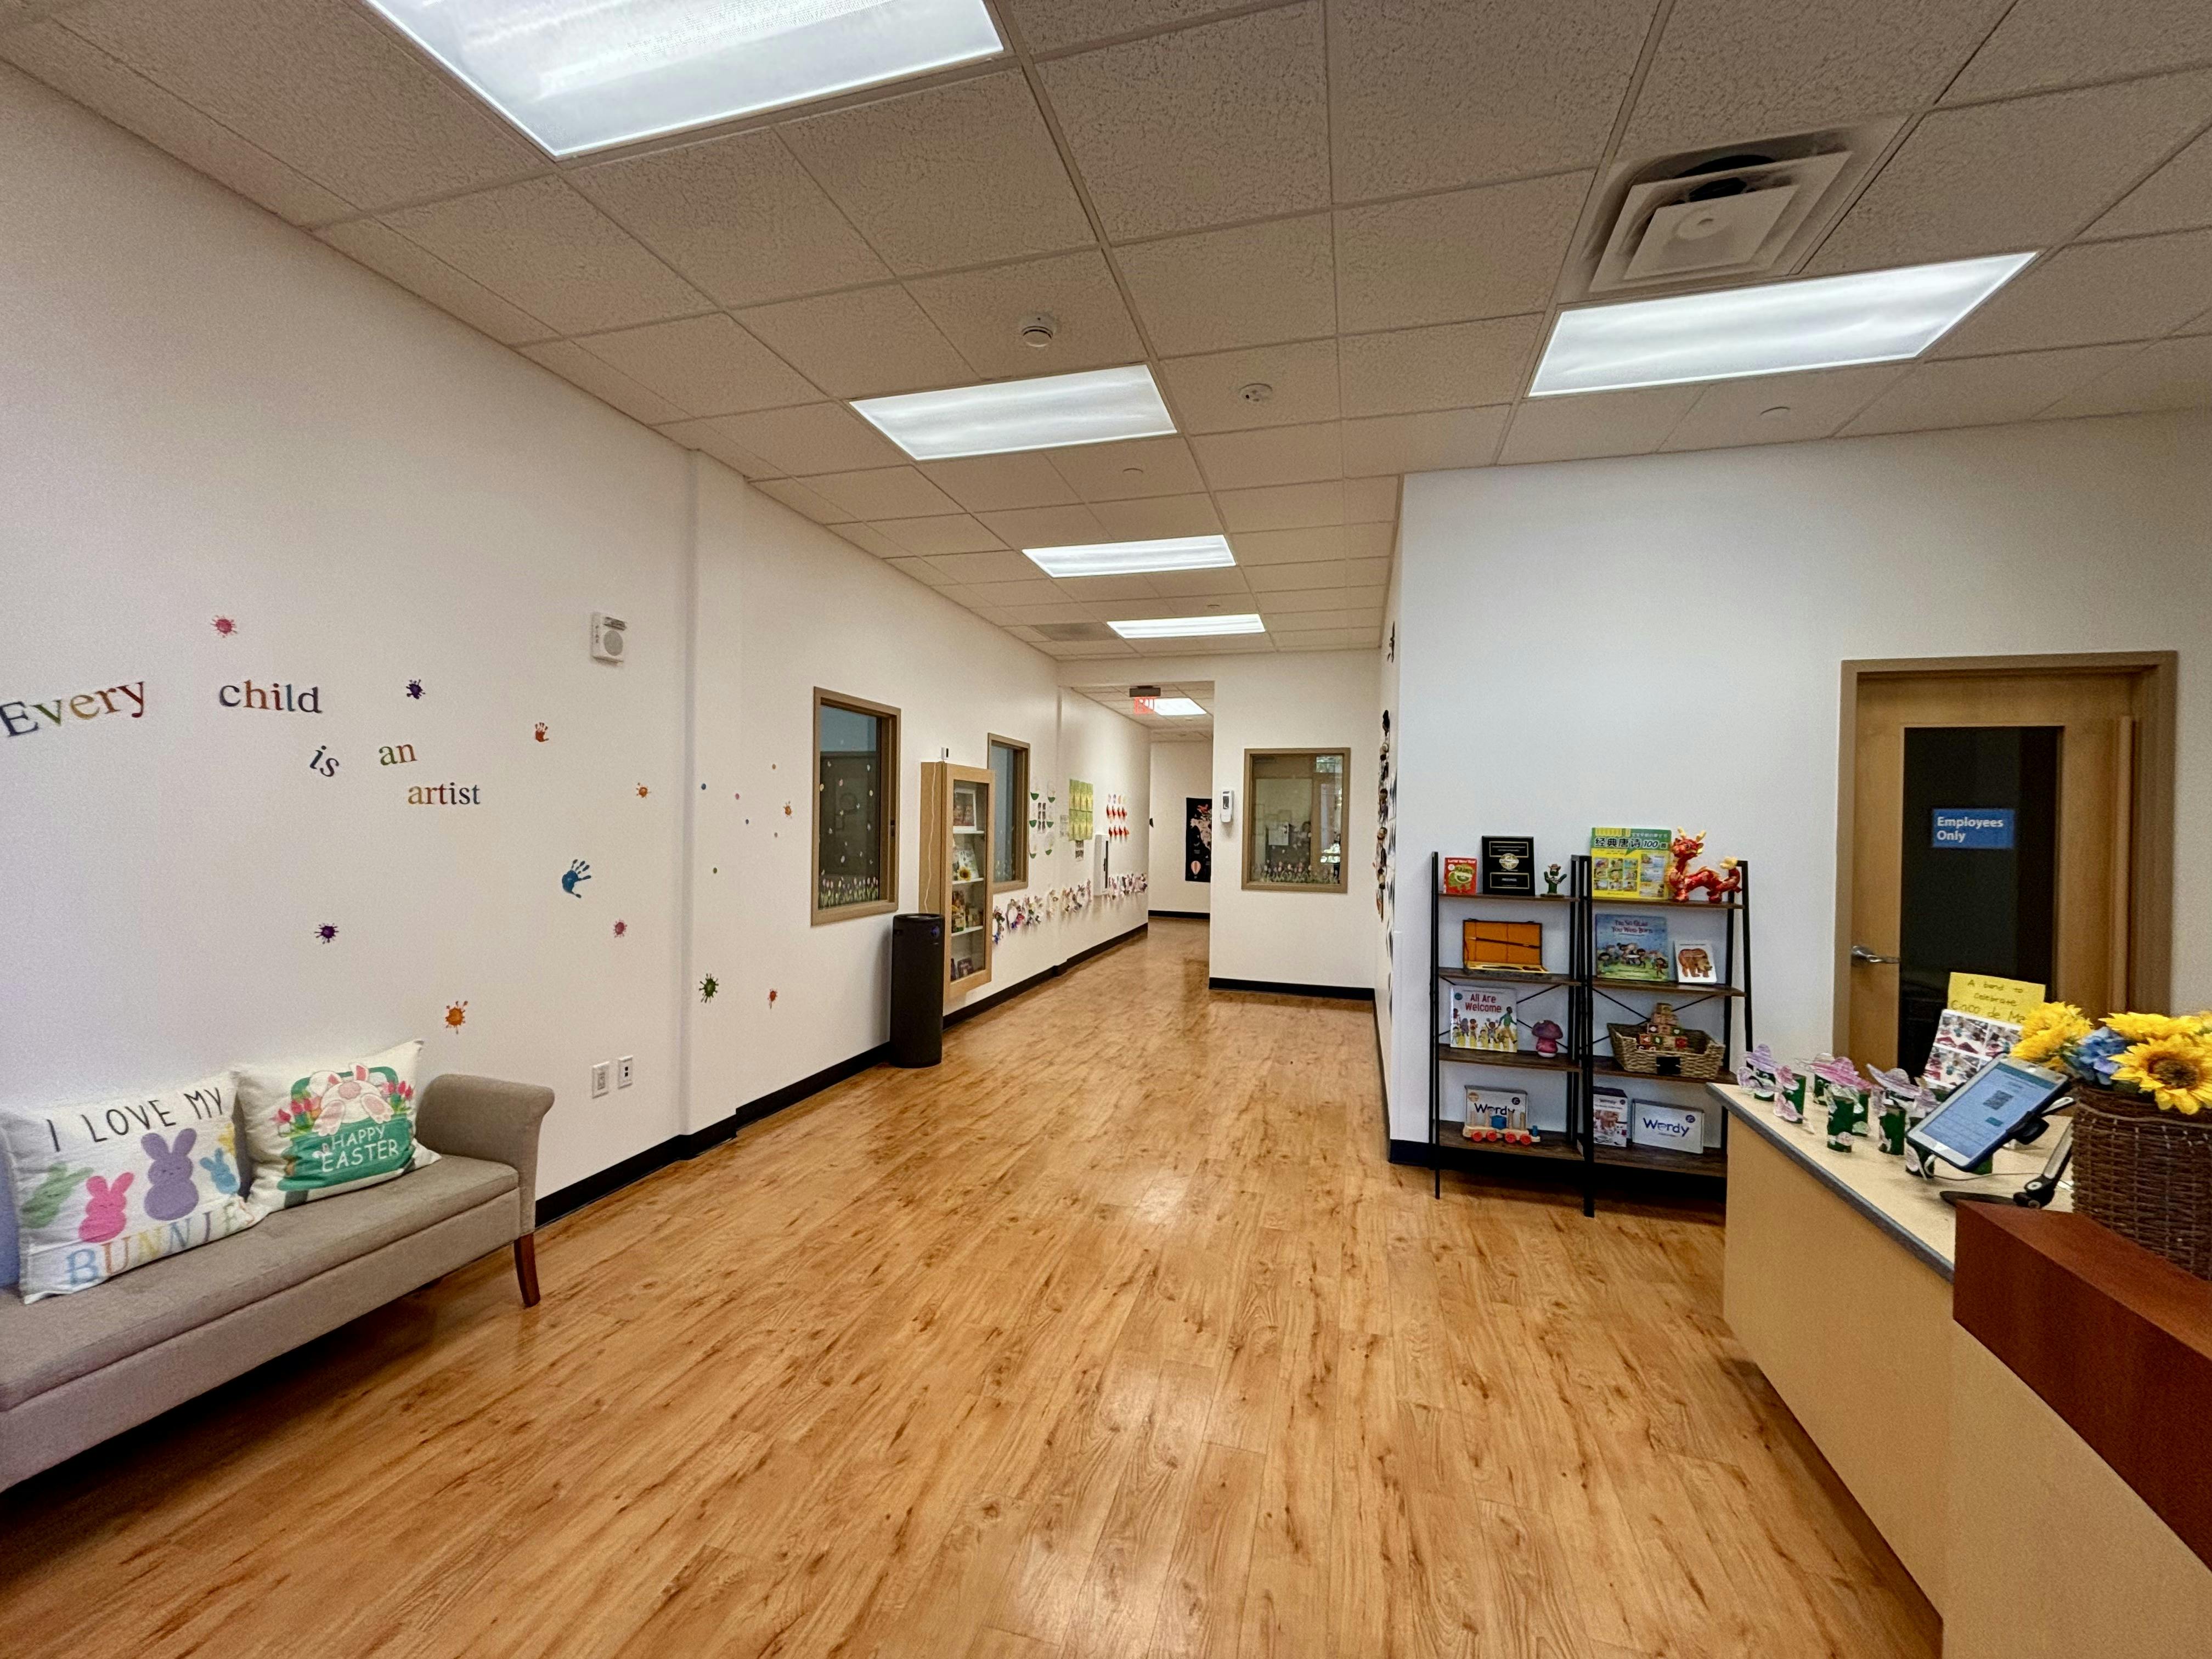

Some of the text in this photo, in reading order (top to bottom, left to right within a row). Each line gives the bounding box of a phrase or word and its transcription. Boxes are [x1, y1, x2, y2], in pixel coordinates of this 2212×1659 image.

[0, 680, 323, 737] Every child
[309, 743, 417, 777] is an
[408, 782, 481, 805] artist
[1937, 816, 2004, 829] Employees
[1937, 830, 1966, 843] Only
[1465, 1002, 1502, 1013] Welcome
[1470, 994, 1497, 1003] All Are
[47, 1087, 223, 1152] I LOVE MY
[331, 1125, 385, 1150] HAPPY
[321, 1139, 399, 1172] EASTER
